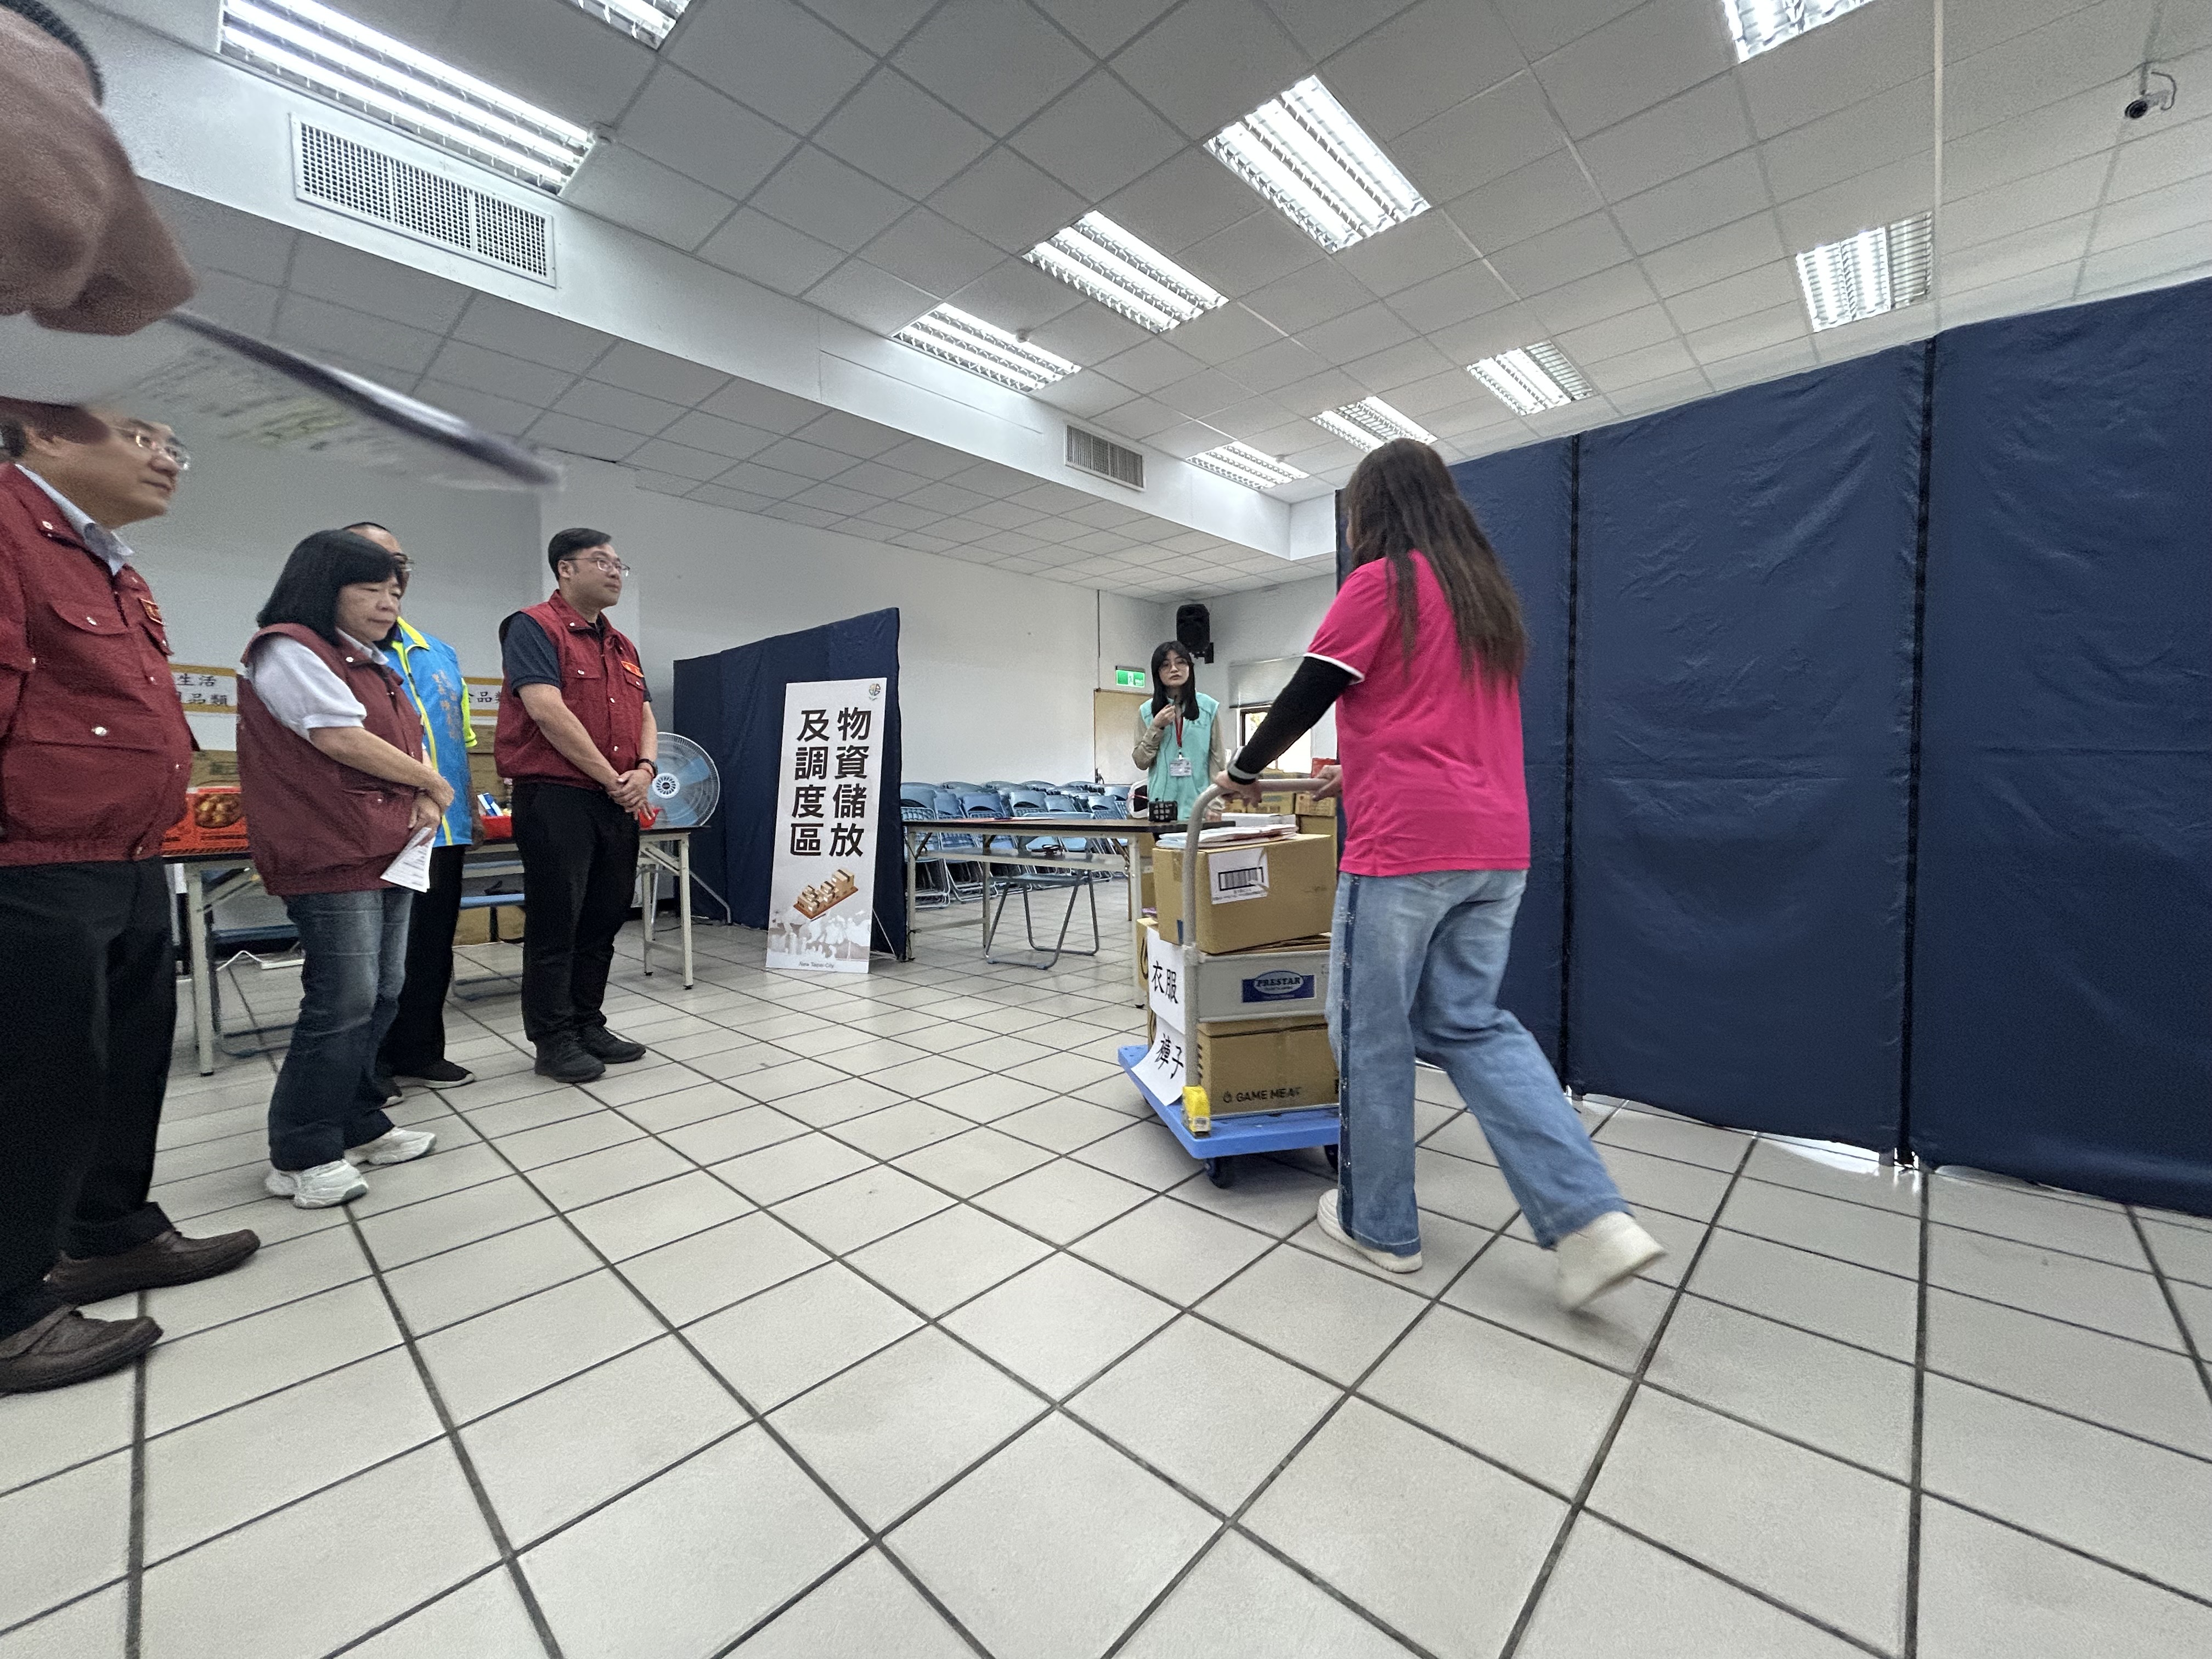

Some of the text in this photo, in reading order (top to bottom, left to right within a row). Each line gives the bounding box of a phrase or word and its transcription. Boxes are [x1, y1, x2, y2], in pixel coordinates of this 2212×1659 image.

[176, 673, 217, 686] 生活
[176, 691, 227, 706] 品類
[791, 709, 830, 856] 及調度區
[829, 707, 872, 857] 物資儲放
[1152, 961, 1178, 1004] 衣服
[1256, 977, 1301, 987] PRESTAR
[1235, 1090, 1267, 1102] GAME
